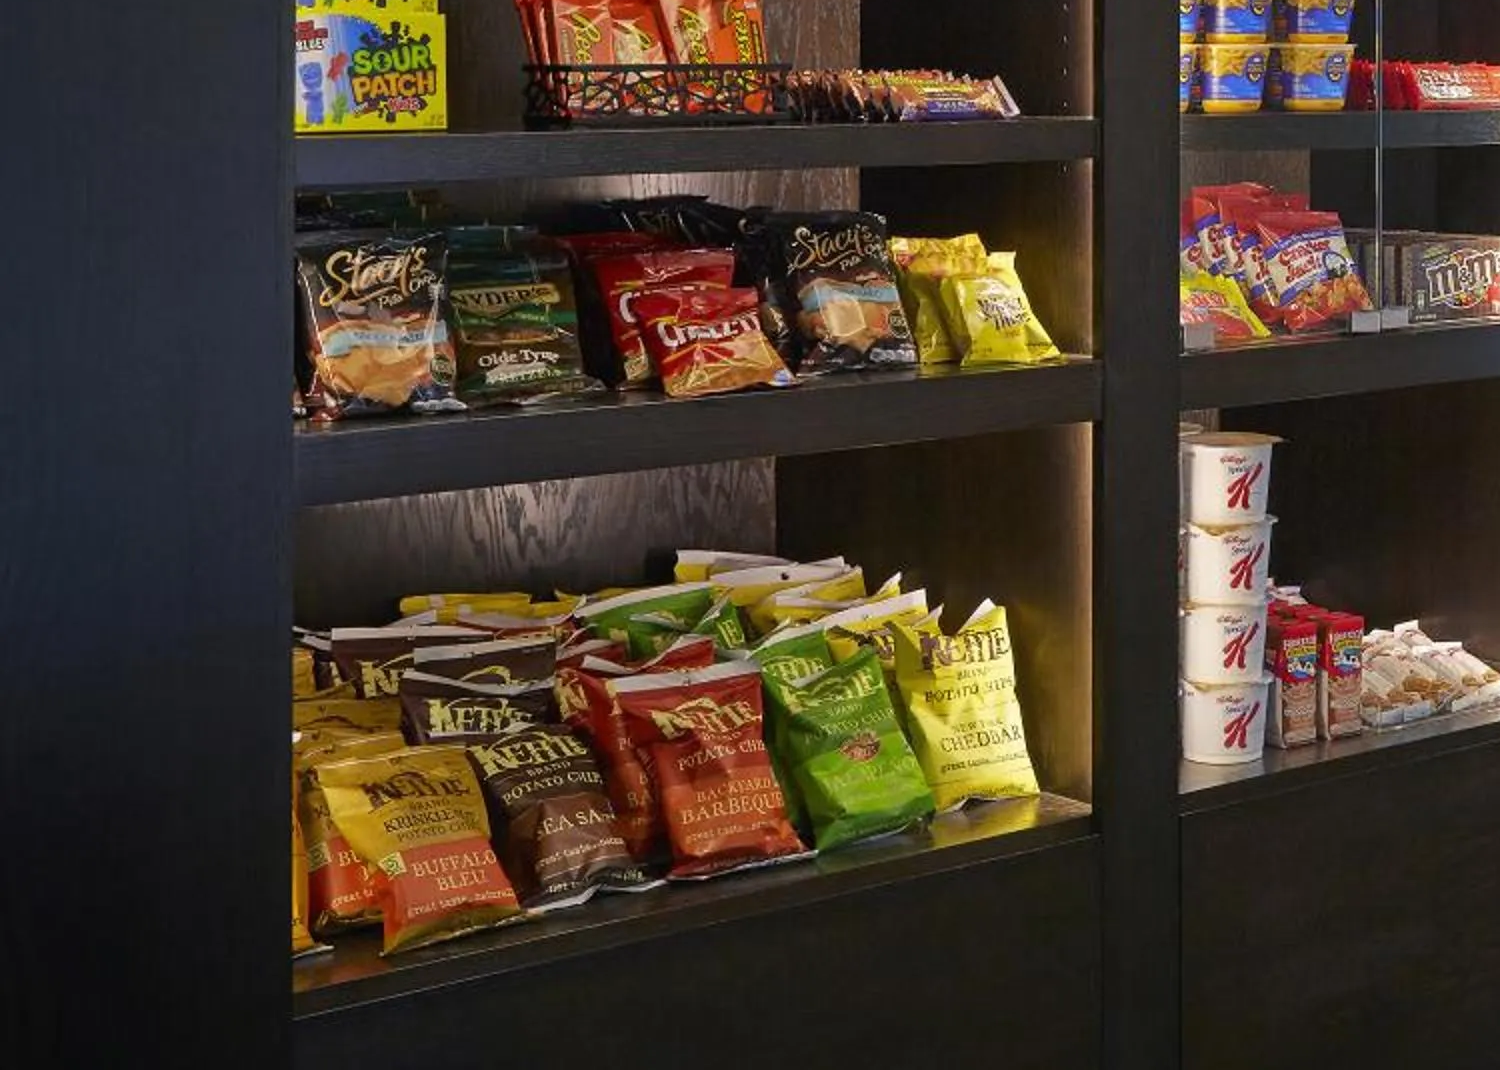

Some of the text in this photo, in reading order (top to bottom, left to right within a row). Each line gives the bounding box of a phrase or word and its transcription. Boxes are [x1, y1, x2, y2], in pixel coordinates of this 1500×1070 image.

[353, 44, 432, 74] SOUR
[352, 66, 437, 104] PATCH
[450, 285, 558, 307] NYDER'S
[1227, 462, 1263, 510] K
[1230, 542, 1265, 590] K
[1223, 621, 1259, 669] K
[941, 726, 1024, 753] CHEDDAR
[1224, 701, 1260, 749] K
[362, 771, 471, 811] KETTLE
[682, 790, 786, 825] BARBEQUE
[411, 849, 499, 878] BUFFALO
[436, 869, 487, 893] BLEU
